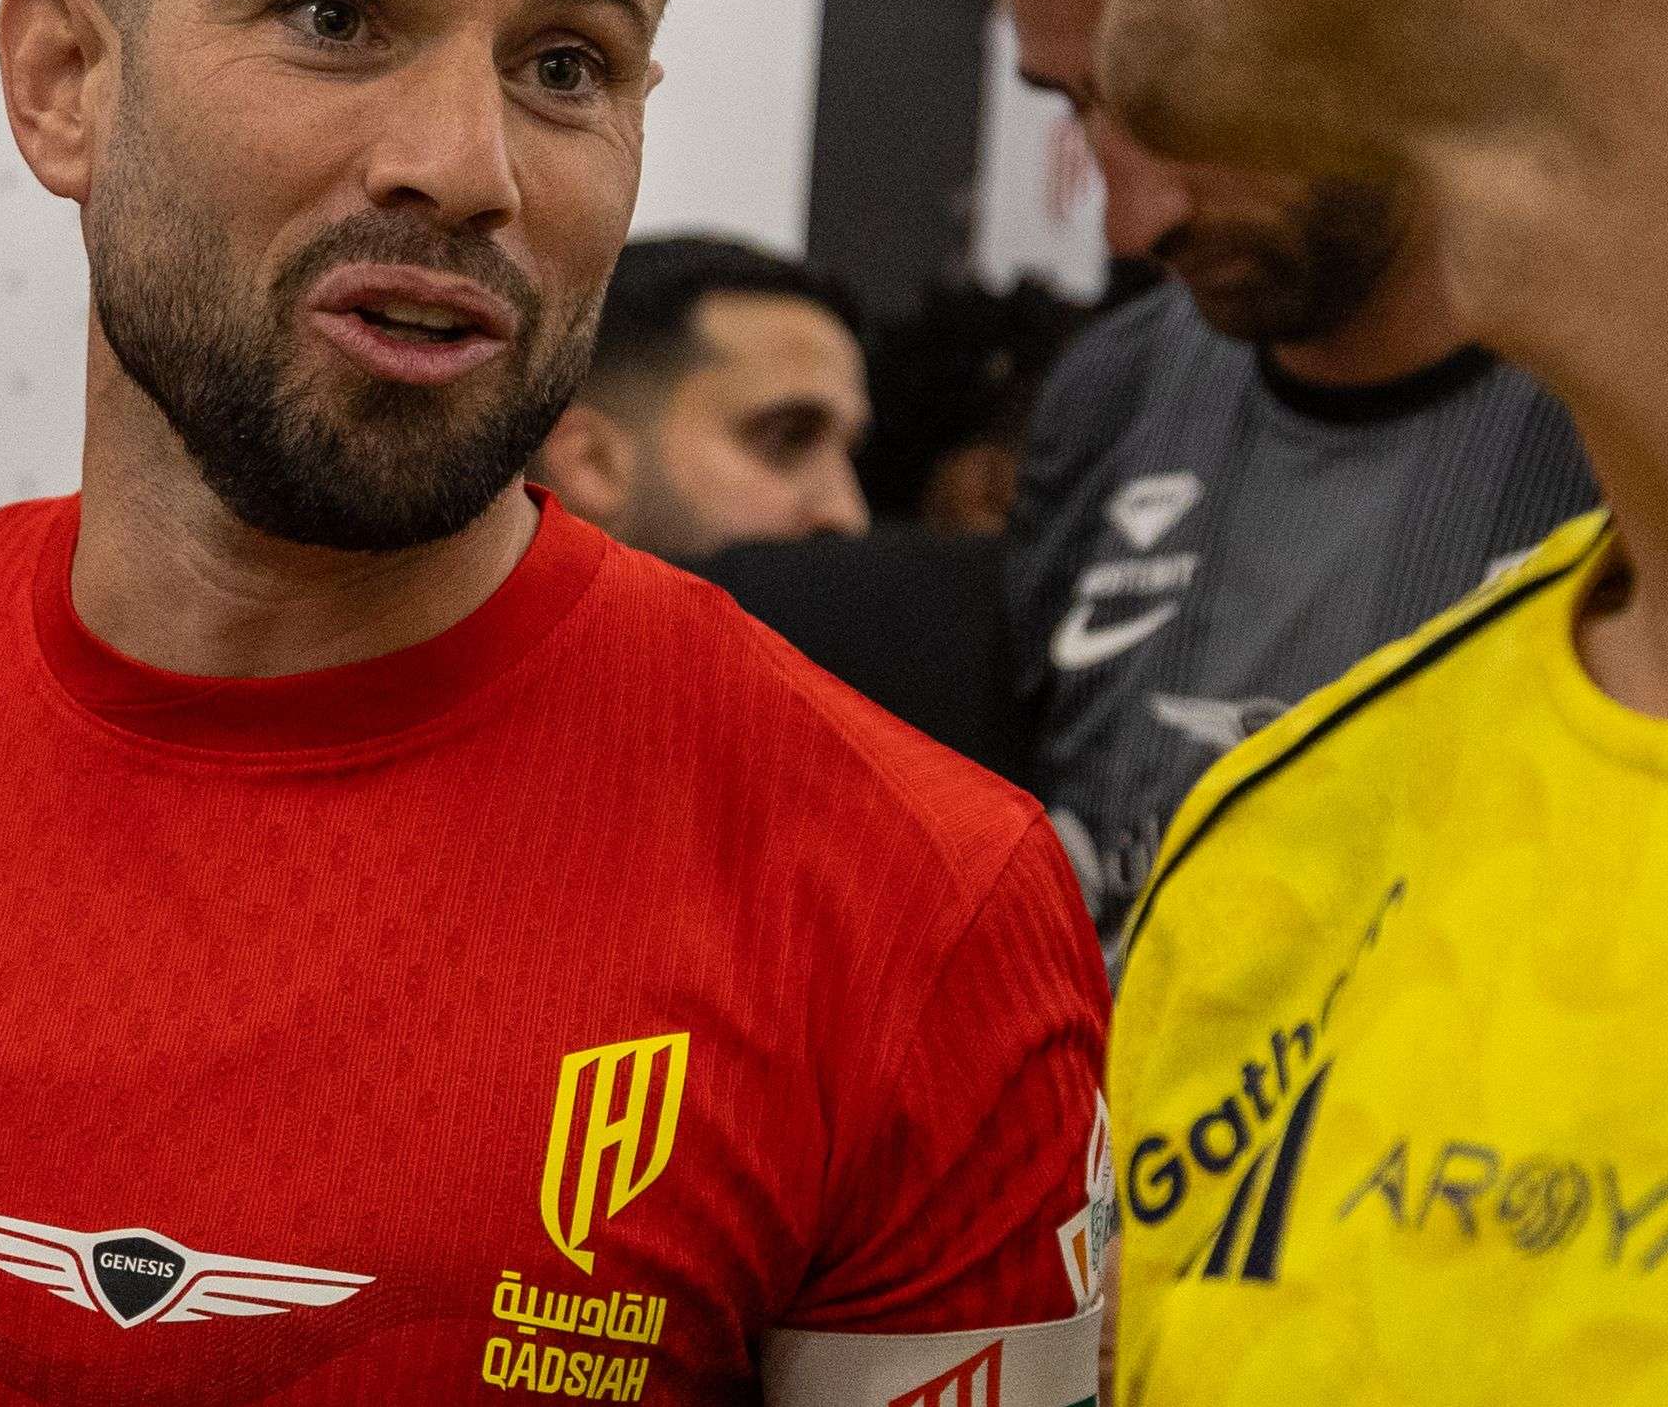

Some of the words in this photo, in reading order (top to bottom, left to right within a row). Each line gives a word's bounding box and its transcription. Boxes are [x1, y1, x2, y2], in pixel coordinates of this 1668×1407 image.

[100, 1252, 176, 1278] GENESIS
[491, 1269, 668, 1345] القادسية
[482, 1337, 650, 1402] QADSIAH
